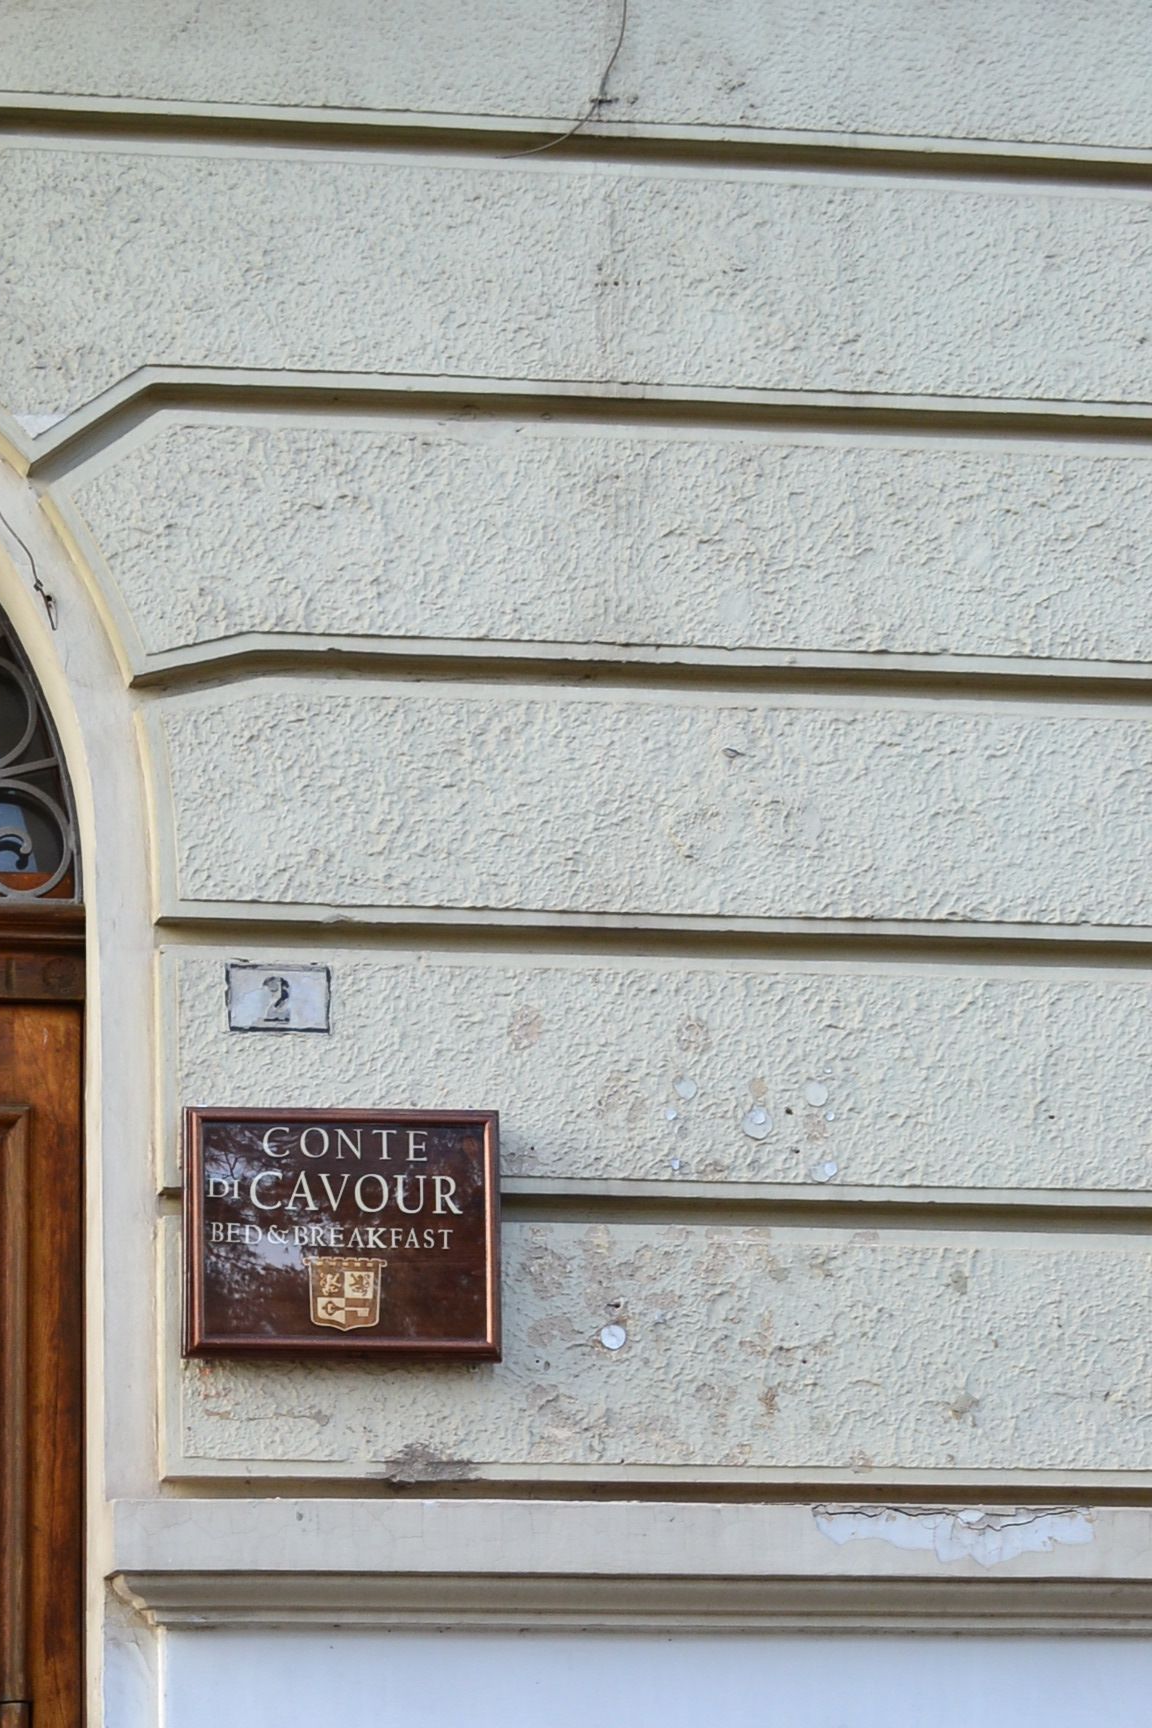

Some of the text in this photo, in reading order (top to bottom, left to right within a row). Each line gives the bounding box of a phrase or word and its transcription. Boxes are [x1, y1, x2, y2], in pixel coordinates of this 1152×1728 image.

[262, 976, 290, 1023] 2
[262, 1126, 429, 1162] CONTE
[206, 1170, 464, 1215] DI CAVOUR
